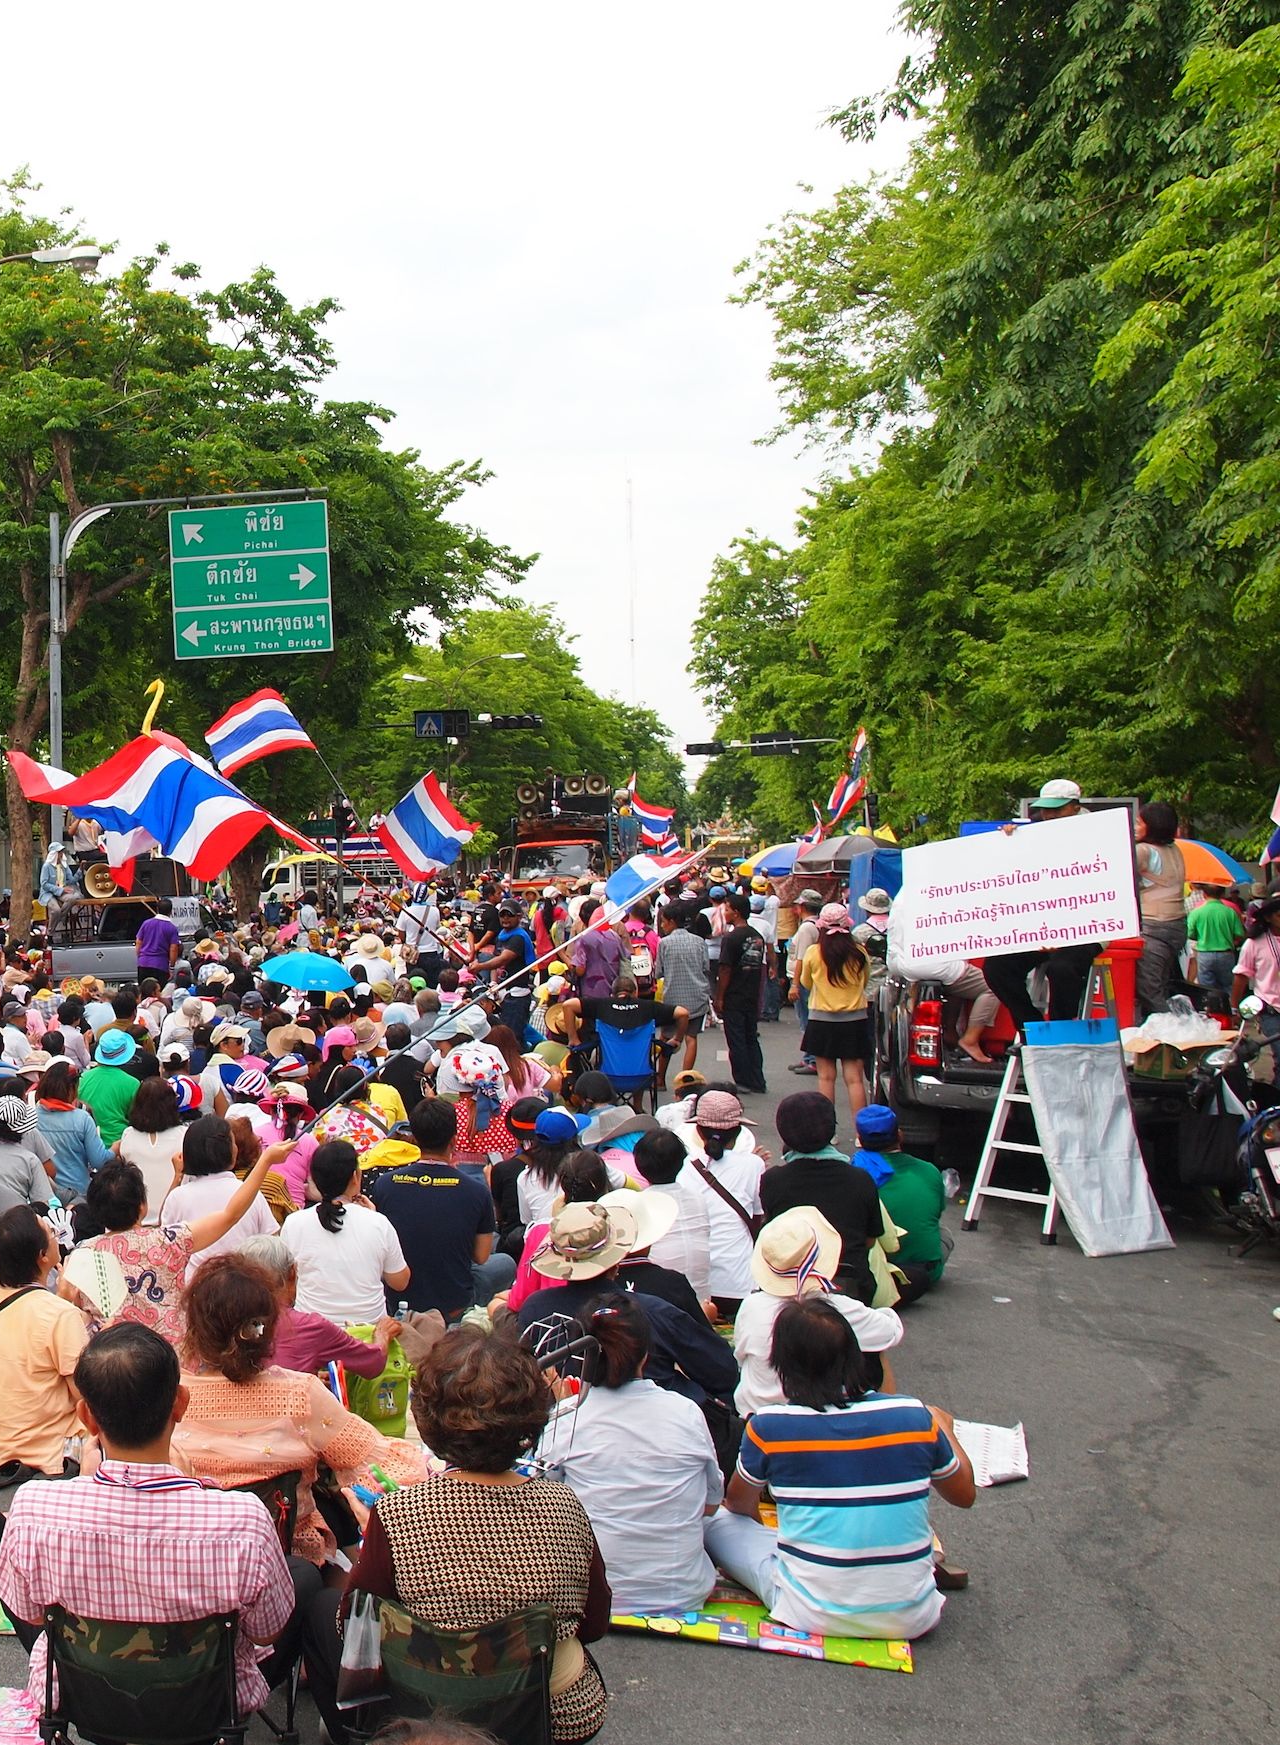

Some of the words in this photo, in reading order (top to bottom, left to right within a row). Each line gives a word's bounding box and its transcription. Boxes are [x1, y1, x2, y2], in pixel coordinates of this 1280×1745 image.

[244, 508, 284, 533] พิชัย
[244, 540, 278, 550] Pichai
[206, 560, 257, 585] ตึกชัย
[207, 594, 226, 603] Tuk
[235, 592, 258, 601] Chai
[214, 642, 245, 653] Krung
[254, 640, 279, 650] Thon
[288, 638, 323, 649] Bridge
